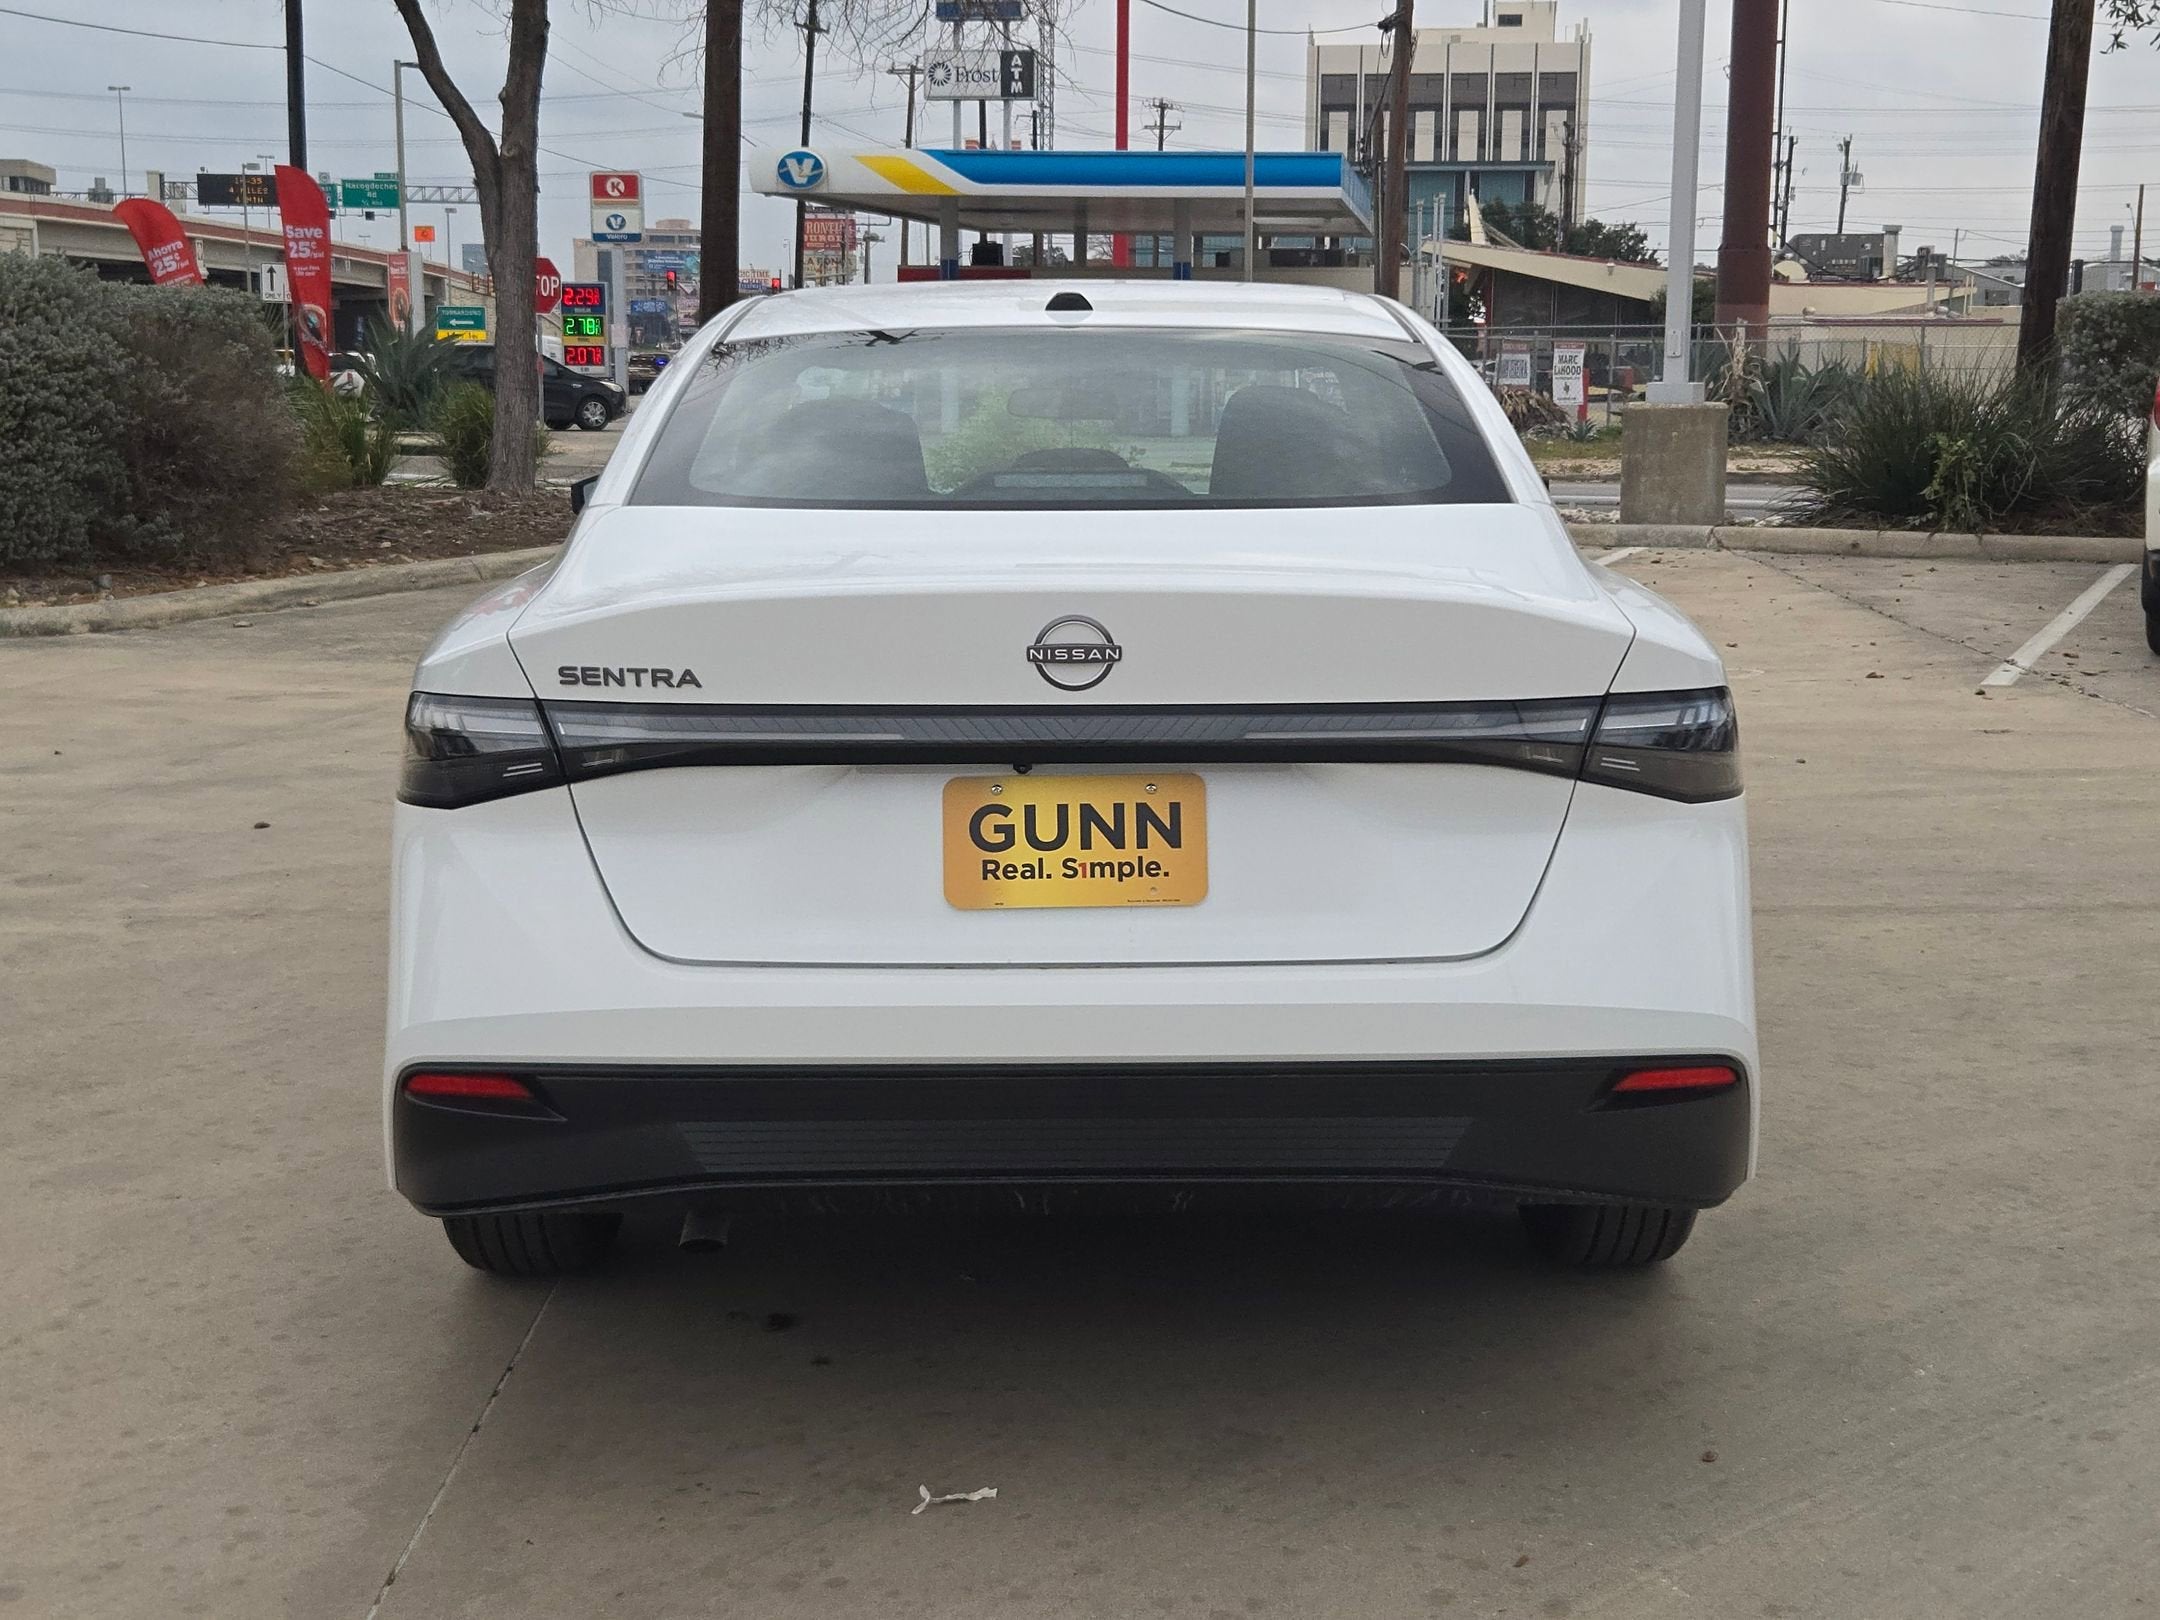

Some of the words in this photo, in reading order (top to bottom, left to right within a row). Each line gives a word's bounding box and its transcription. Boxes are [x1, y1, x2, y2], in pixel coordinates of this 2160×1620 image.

[955, 66, 1000, 83] Frost
[1010, 54, 1023, 93] ATM
[286, 225, 323, 239] Save
[148, 241, 184, 260] Ahorra
[1557, 354, 1579, 365] MARC
[1029, 648, 1120, 661] NISSAN
[558, 665, 703, 689] SENTRA
[968, 801, 1182, 853] GUNN
[982, 858, 1052, 881] Real.
